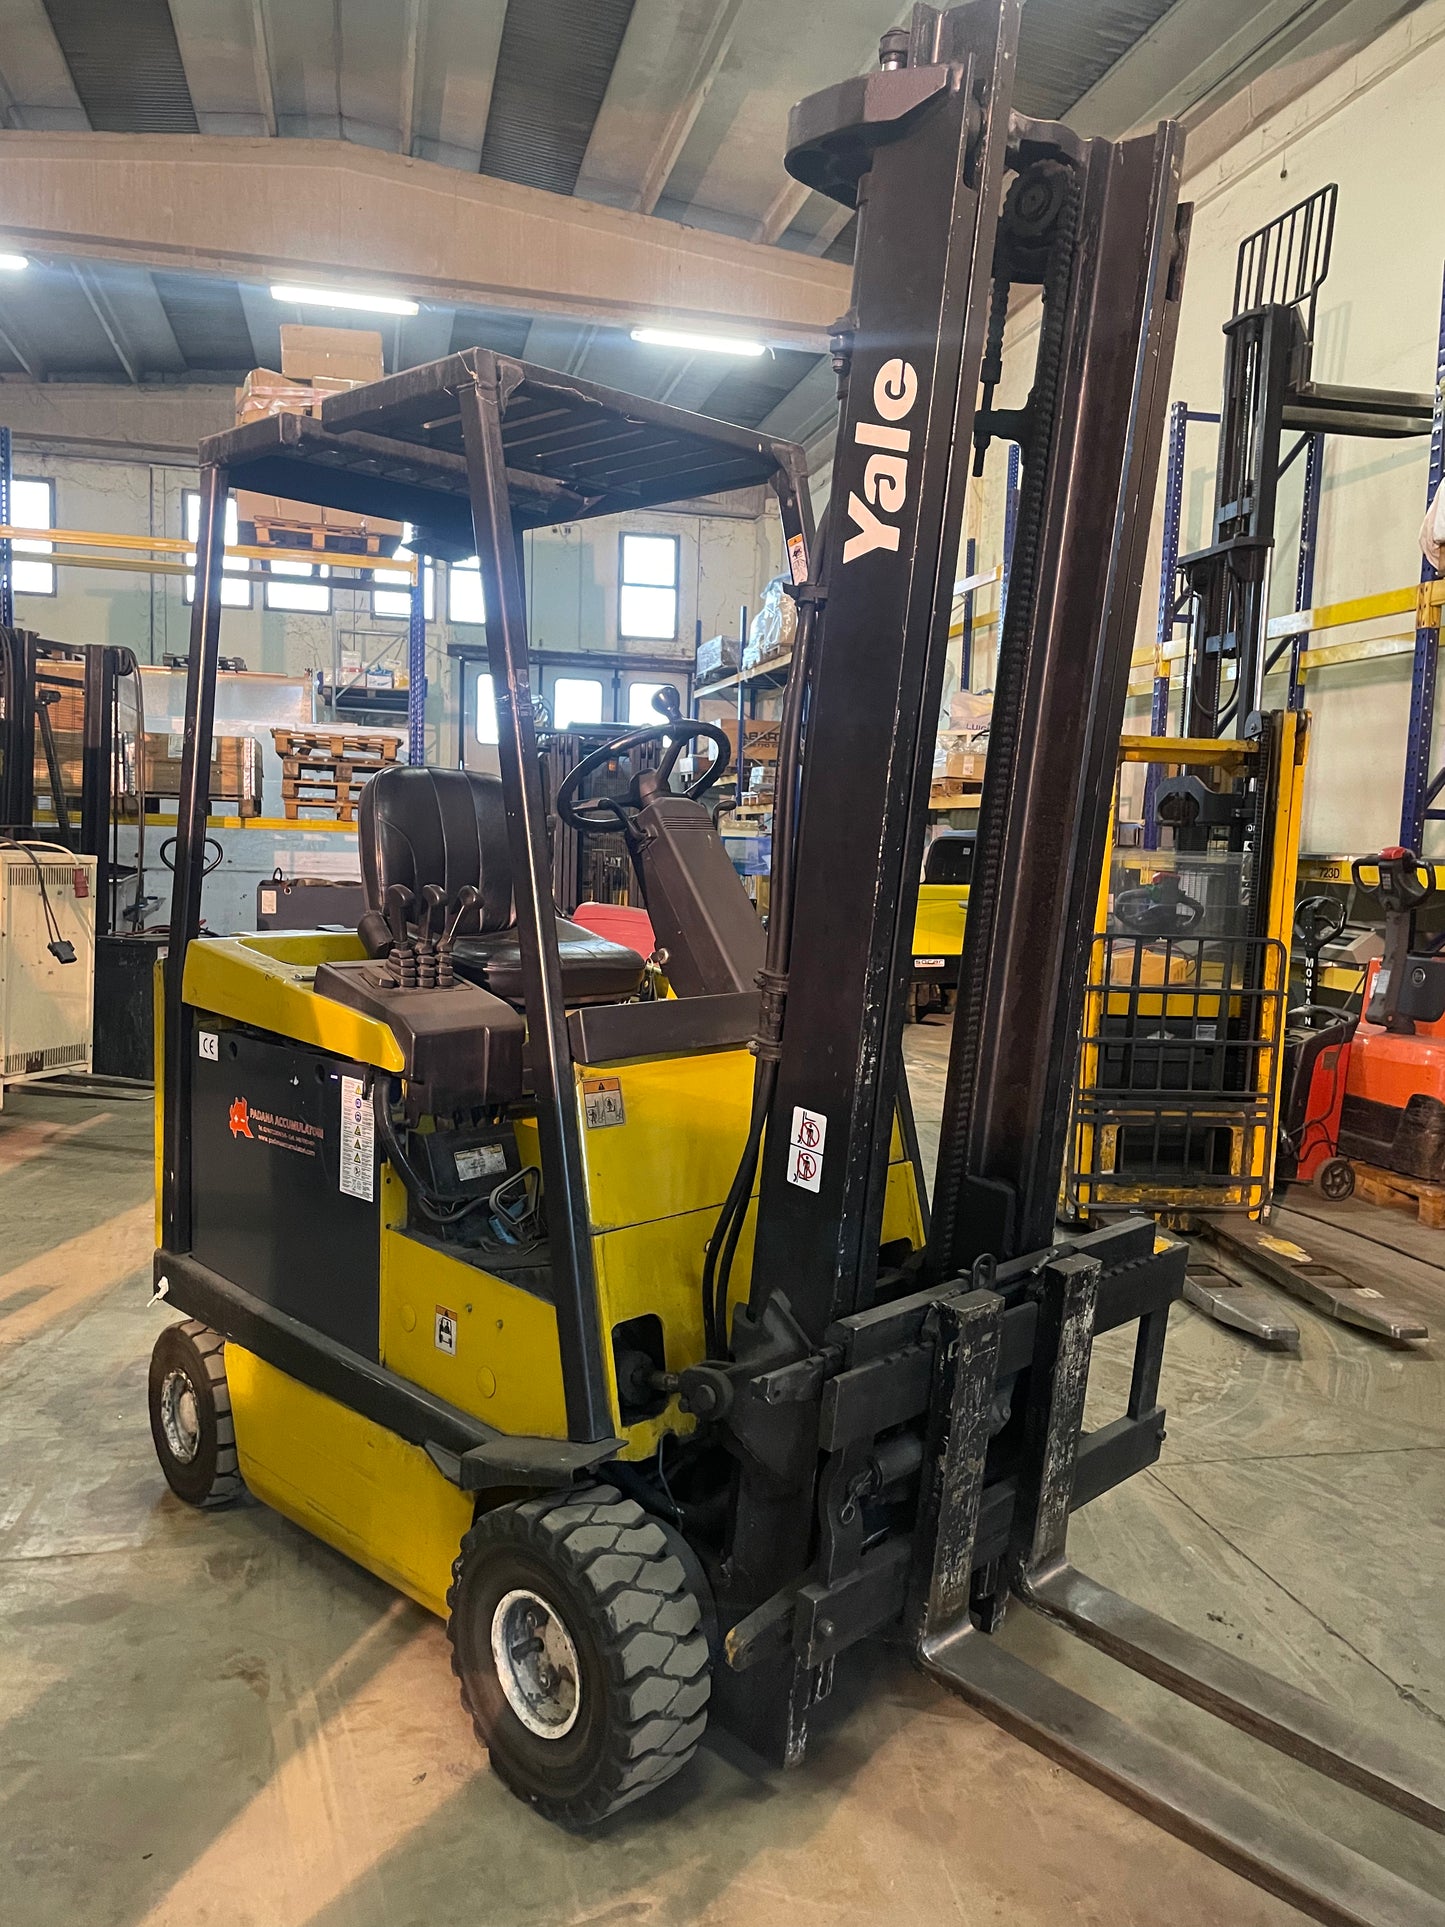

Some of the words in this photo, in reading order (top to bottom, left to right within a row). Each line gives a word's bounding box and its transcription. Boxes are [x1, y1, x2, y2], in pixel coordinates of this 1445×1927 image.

[842, 358, 918, 564] Yale
[743, 731, 779, 741] ABAR
[1319, 867, 1340, 879] 723D
[1304, 957, 1314, 1026] MONTAN
